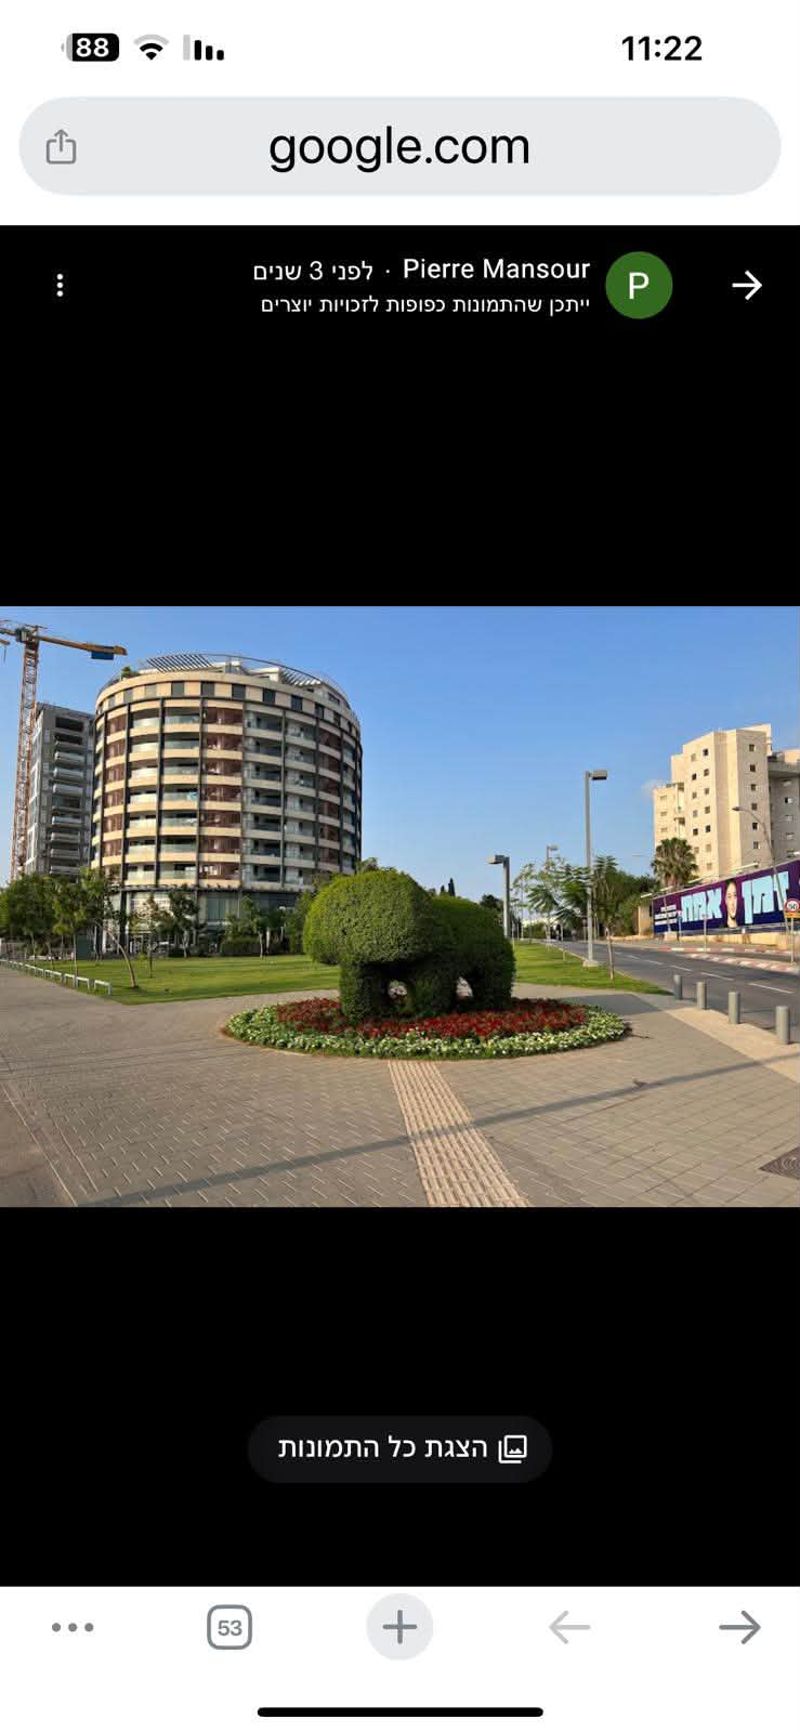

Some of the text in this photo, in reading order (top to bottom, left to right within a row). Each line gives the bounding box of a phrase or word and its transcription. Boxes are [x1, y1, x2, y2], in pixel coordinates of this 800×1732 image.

[75, 37, 110, 58] 88
[621, 35, 703, 61] 11:22
[269, 126, 530, 173] google.com
[253, 258, 591, 281] Pierre Mansour לפני 3 שנים
[629, 271, 650, 300] P
[261, 295, 591, 317] ייתכן שהתמונות כפופות לזכויות יוצרים
[741, 871, 789, 924] זמן
[278, 1434, 488, 1458] הצגת כל התמונות
[217, 1618, 243, 1637] 53
